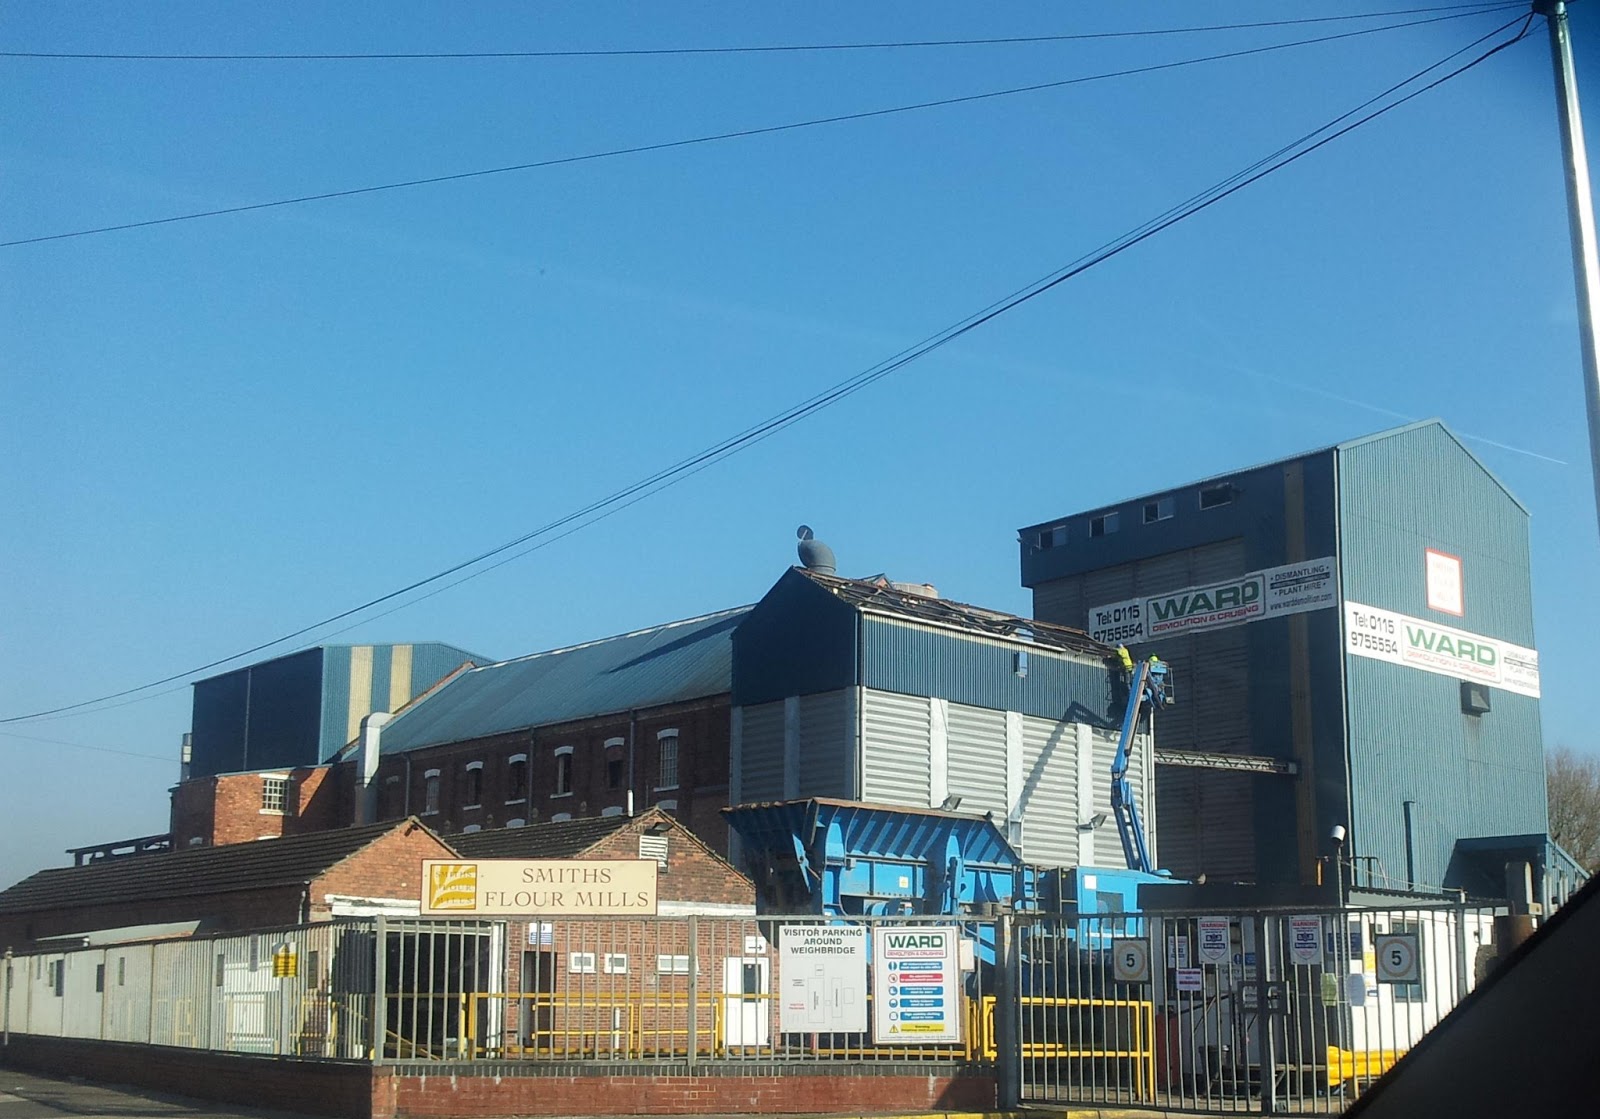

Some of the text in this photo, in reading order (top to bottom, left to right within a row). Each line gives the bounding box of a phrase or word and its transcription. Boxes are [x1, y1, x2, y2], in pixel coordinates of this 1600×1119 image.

[1275, 565, 1325, 581] DISMANTLING
[1278, 581, 1322, 597] PLANT HIRE
[1152, 581, 1260, 620] WARD
[1096, 605, 1140, 626] Tel: 0115
[1152, 616, 1208, 632] DEMOLITION
[1208, 615, 1217, 623] &
[1353, 611, 1395, 634] Tel: 0115
[1093, 622, 1143, 643] 9755554
[1351, 631, 1398, 655] 9755554
[1406, 625, 1496, 666] WARD
[1406, 649, 1453, 667] DEMOLITION
[522, 867, 612, 884] SMITHS
[485, 891, 649, 907] FLOUR MILLS
[784, 928, 863, 937] VISITOR PARKING
[790, 946, 856, 955] WEIGHBRIDGE
[888, 935, 943, 949] WARD
[1126, 953, 1136, 968] 5
[1391, 950, 1402, 966] 5
